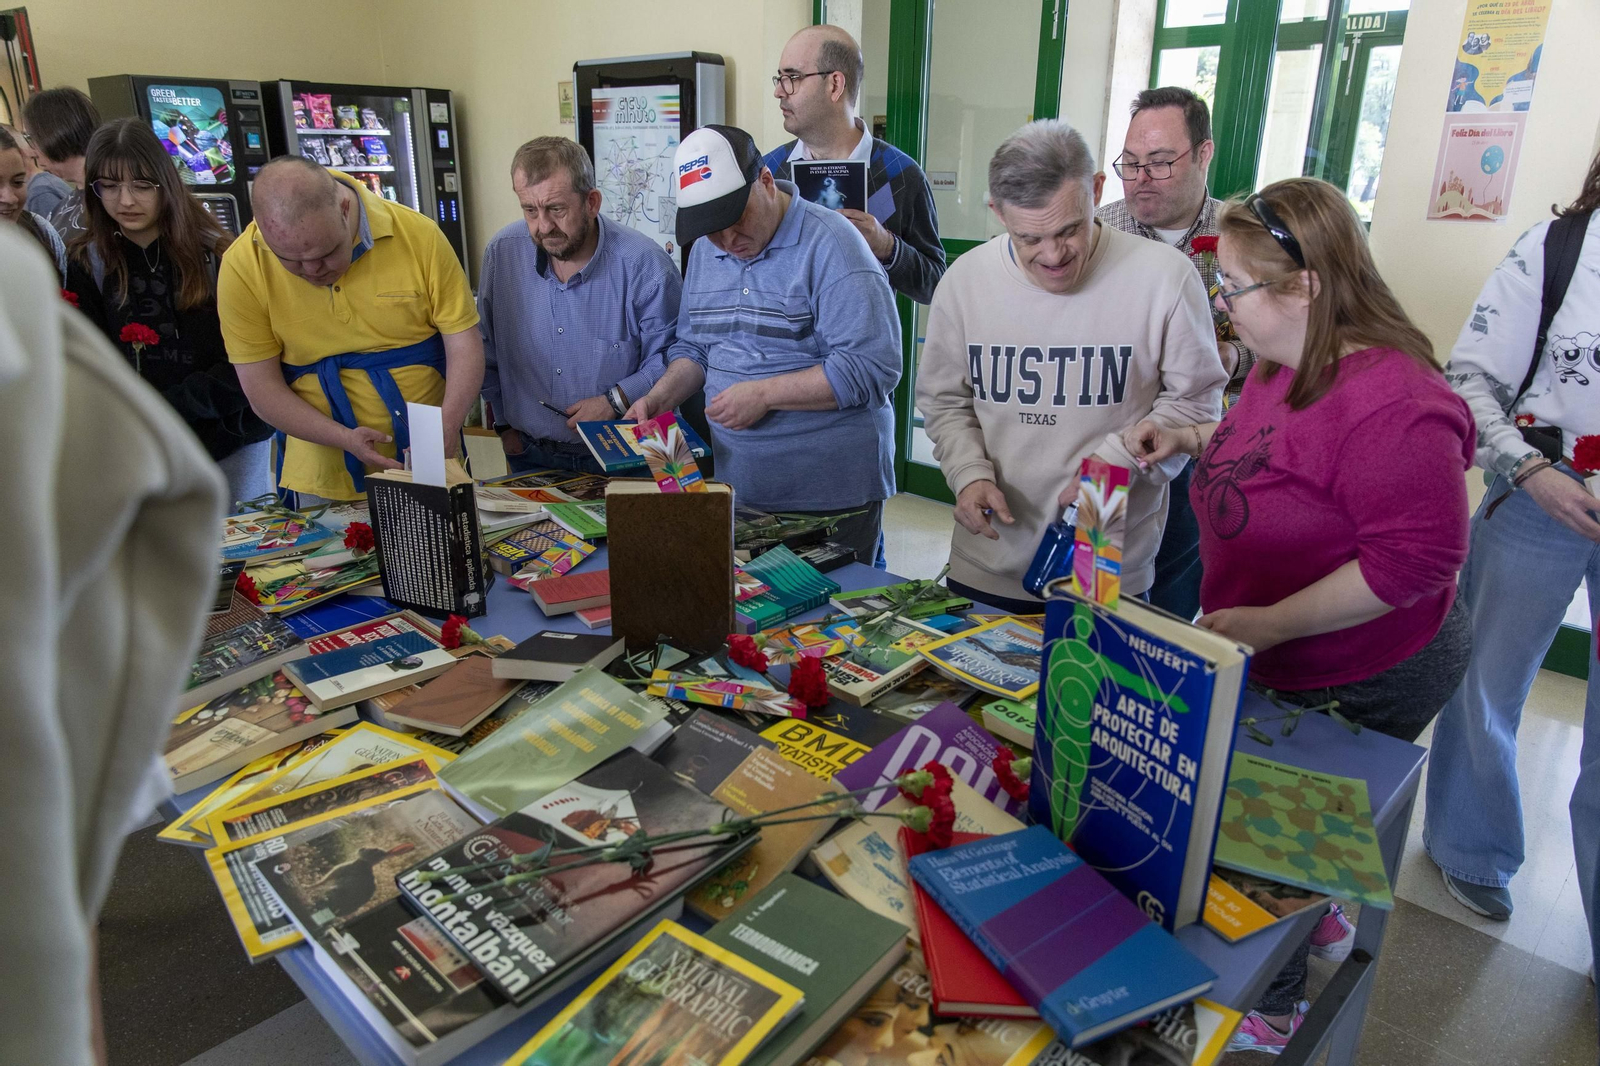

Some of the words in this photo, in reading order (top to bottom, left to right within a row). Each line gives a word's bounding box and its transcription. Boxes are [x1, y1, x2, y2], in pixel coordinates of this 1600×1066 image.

[1345, 15, 1381, 30] ALIDA
[150, 88, 176, 98] GREEN
[172, 97, 202, 106] BETTER
[1452, 128, 1468, 137] Feliz
[1481, 128, 1493, 137] del
[1494, 128, 1514, 137] Libro
[679, 155, 709, 176] PEPSI
[968, 343, 1133, 407] AUSTIN
[1019, 412, 1057, 426] TEXAS
[465, 556, 476, 591] aplicada
[944, 646, 1030, 687] GEOGRAPHIC
[949, 654, 1006, 686] NATIONAL
[1128, 634, 1189, 675] NEUFERT
[994, 703, 1037, 729] CADO
[1116, 694, 1156, 729] ARTE
[1160, 718, 1180, 744] DE
[354, 747, 395, 766] GEOGRA
[372, 744, 406, 762] NATION
[776, 740, 846, 776] STATISTIC
[778, 723, 869, 766] BMD
[963, 738, 993, 764] BIBLIOTE
[1093, 702, 1172, 765] PROYECTAR
[1176, 753, 1198, 782] EN
[1091, 726, 1192, 806] ARQUITECTURA
[938, 857, 1004, 883] Elements
[950, 866, 1020, 894] Statistical
[1021, 852, 1078, 878] Analysis
[400, 870, 531, 995] montalbán
[484, 908, 557, 974] vázquez
[730, 922, 820, 976] TERMODINAMICA
[662, 949, 751, 1010] NATIONAL
[1080, 984, 1130, 1010] Gruyter
[626, 957, 753, 1039] GEOGRAPHIC
